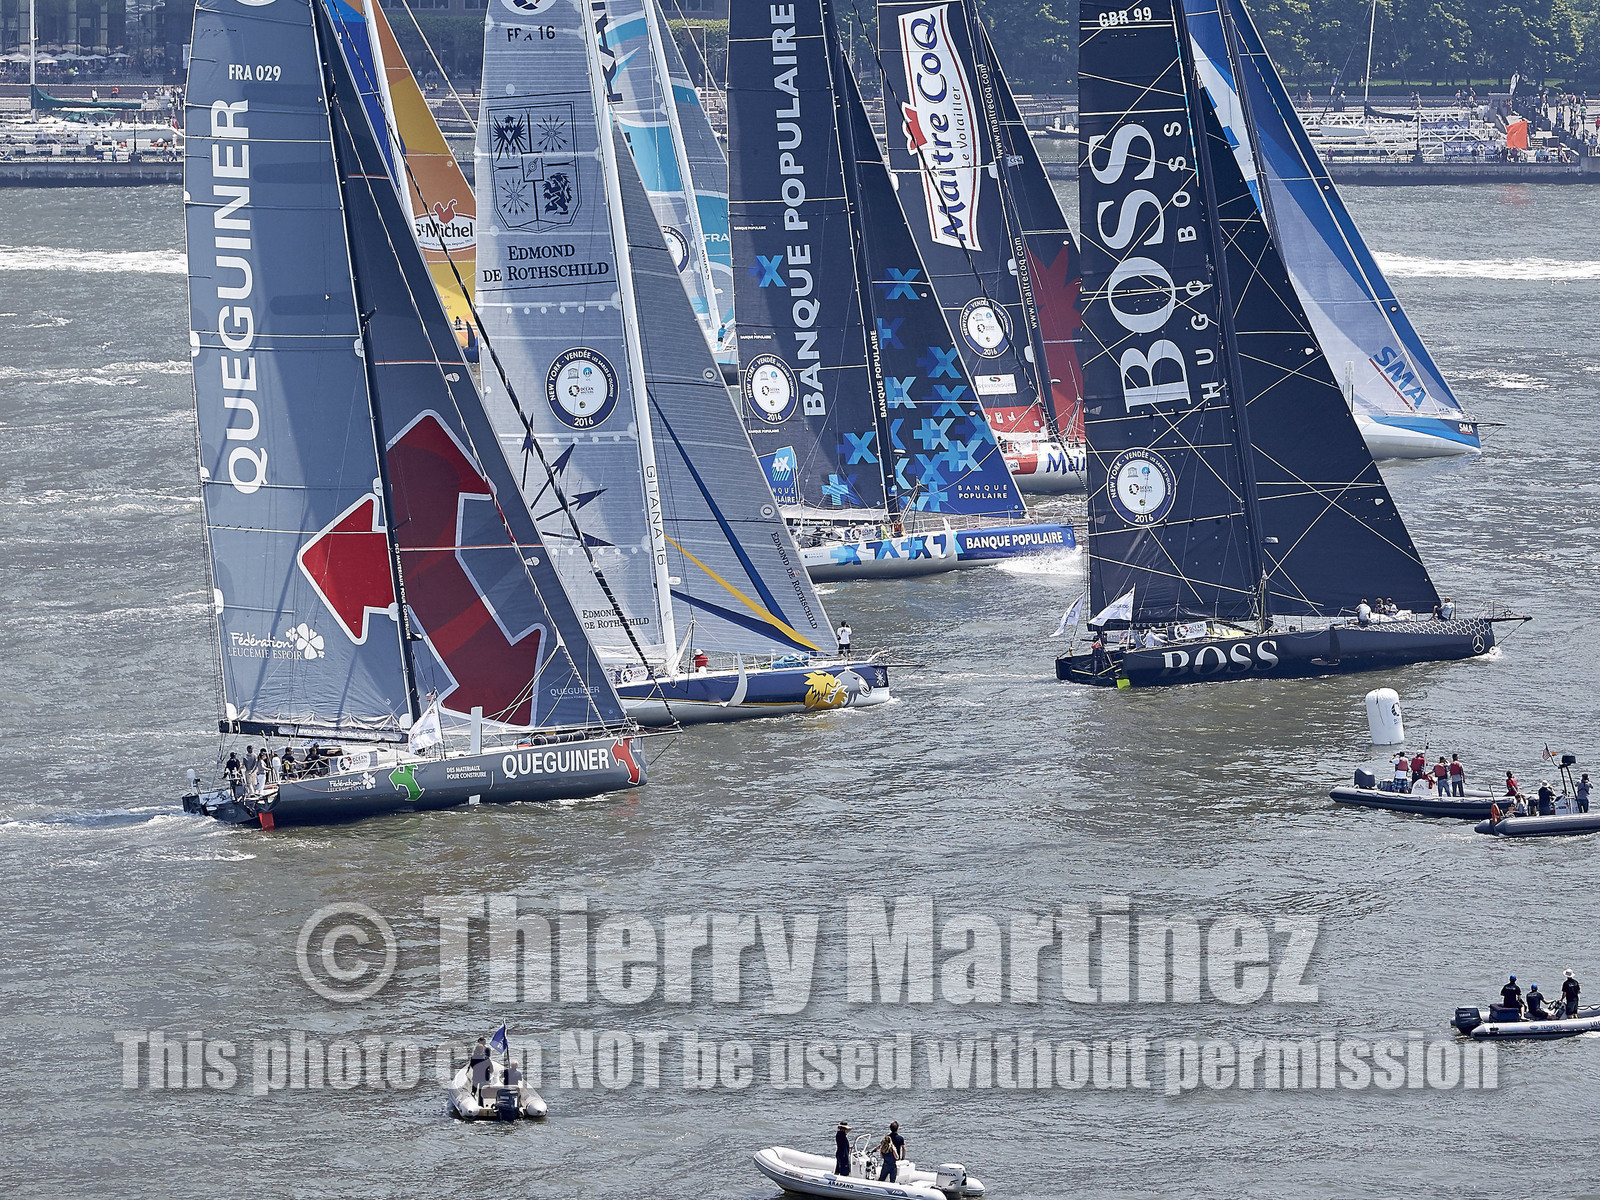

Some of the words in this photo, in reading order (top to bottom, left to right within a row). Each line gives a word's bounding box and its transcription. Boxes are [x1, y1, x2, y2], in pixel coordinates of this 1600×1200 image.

[1098, 10, 1130, 28] GBR
[1133, 6, 1152, 22] 99
[538, 25, 556, 40] 16
[228, 64, 253, 81] FRA
[255, 65, 281, 81] 029
[769, 3, 809, 231] POPULAIRE
[951, 86, 968, 150] Volailler
[1163, 121, 1198, 243] BOSS
[507, 244, 576, 261] EDMOND
[483, 269, 503, 283] DE
[507, 262, 610, 281] ROTHSCHILD
[1089, 123, 1193, 413] BOSS
[1014, 237, 1038, 330] www.maitrecoq.com
[210, 99, 269, 495] QUEGUINER
[786, 243, 828, 417] BANQUE
[1185, 279, 1220, 401] HUGO
[564, 350, 592, 361] VENDÉE
[869, 330, 883, 378] POPULAIRE
[548, 361, 562, 381] YORK
[1372, 346, 1427, 410] SMA
[548, 383, 556, 401] NEW
[876, 380, 888, 418] BANQUE
[573, 417, 594, 427] 2016
[766, 413, 782, 421] 2016
[1458, 423, 1474, 434] SMA
[1124, 450, 1149, 460] VENDÉE
[1110, 461, 1122, 480] YORK
[772, 487, 795, 495] NQUE
[1109, 481, 1117, 498] NEW
[646, 465, 664, 540] GITANA
[655, 546, 667, 566] 16
[1134, 514, 1154, 523] 2016
[965, 535, 1011, 550] BANQUE
[1012, 531, 1064, 546] POPULAIRE
[771, 531, 790, 566] EDMOND
[786, 567, 796, 579] DE
[792, 580, 818, 630] ROTHSCHILD
[584, 621, 596, 629] DE
[272, 648, 303, 661] ESPOIR
[1158, 640, 1280, 677] BOSS
[502, 748, 610, 779] QUEGUINER
